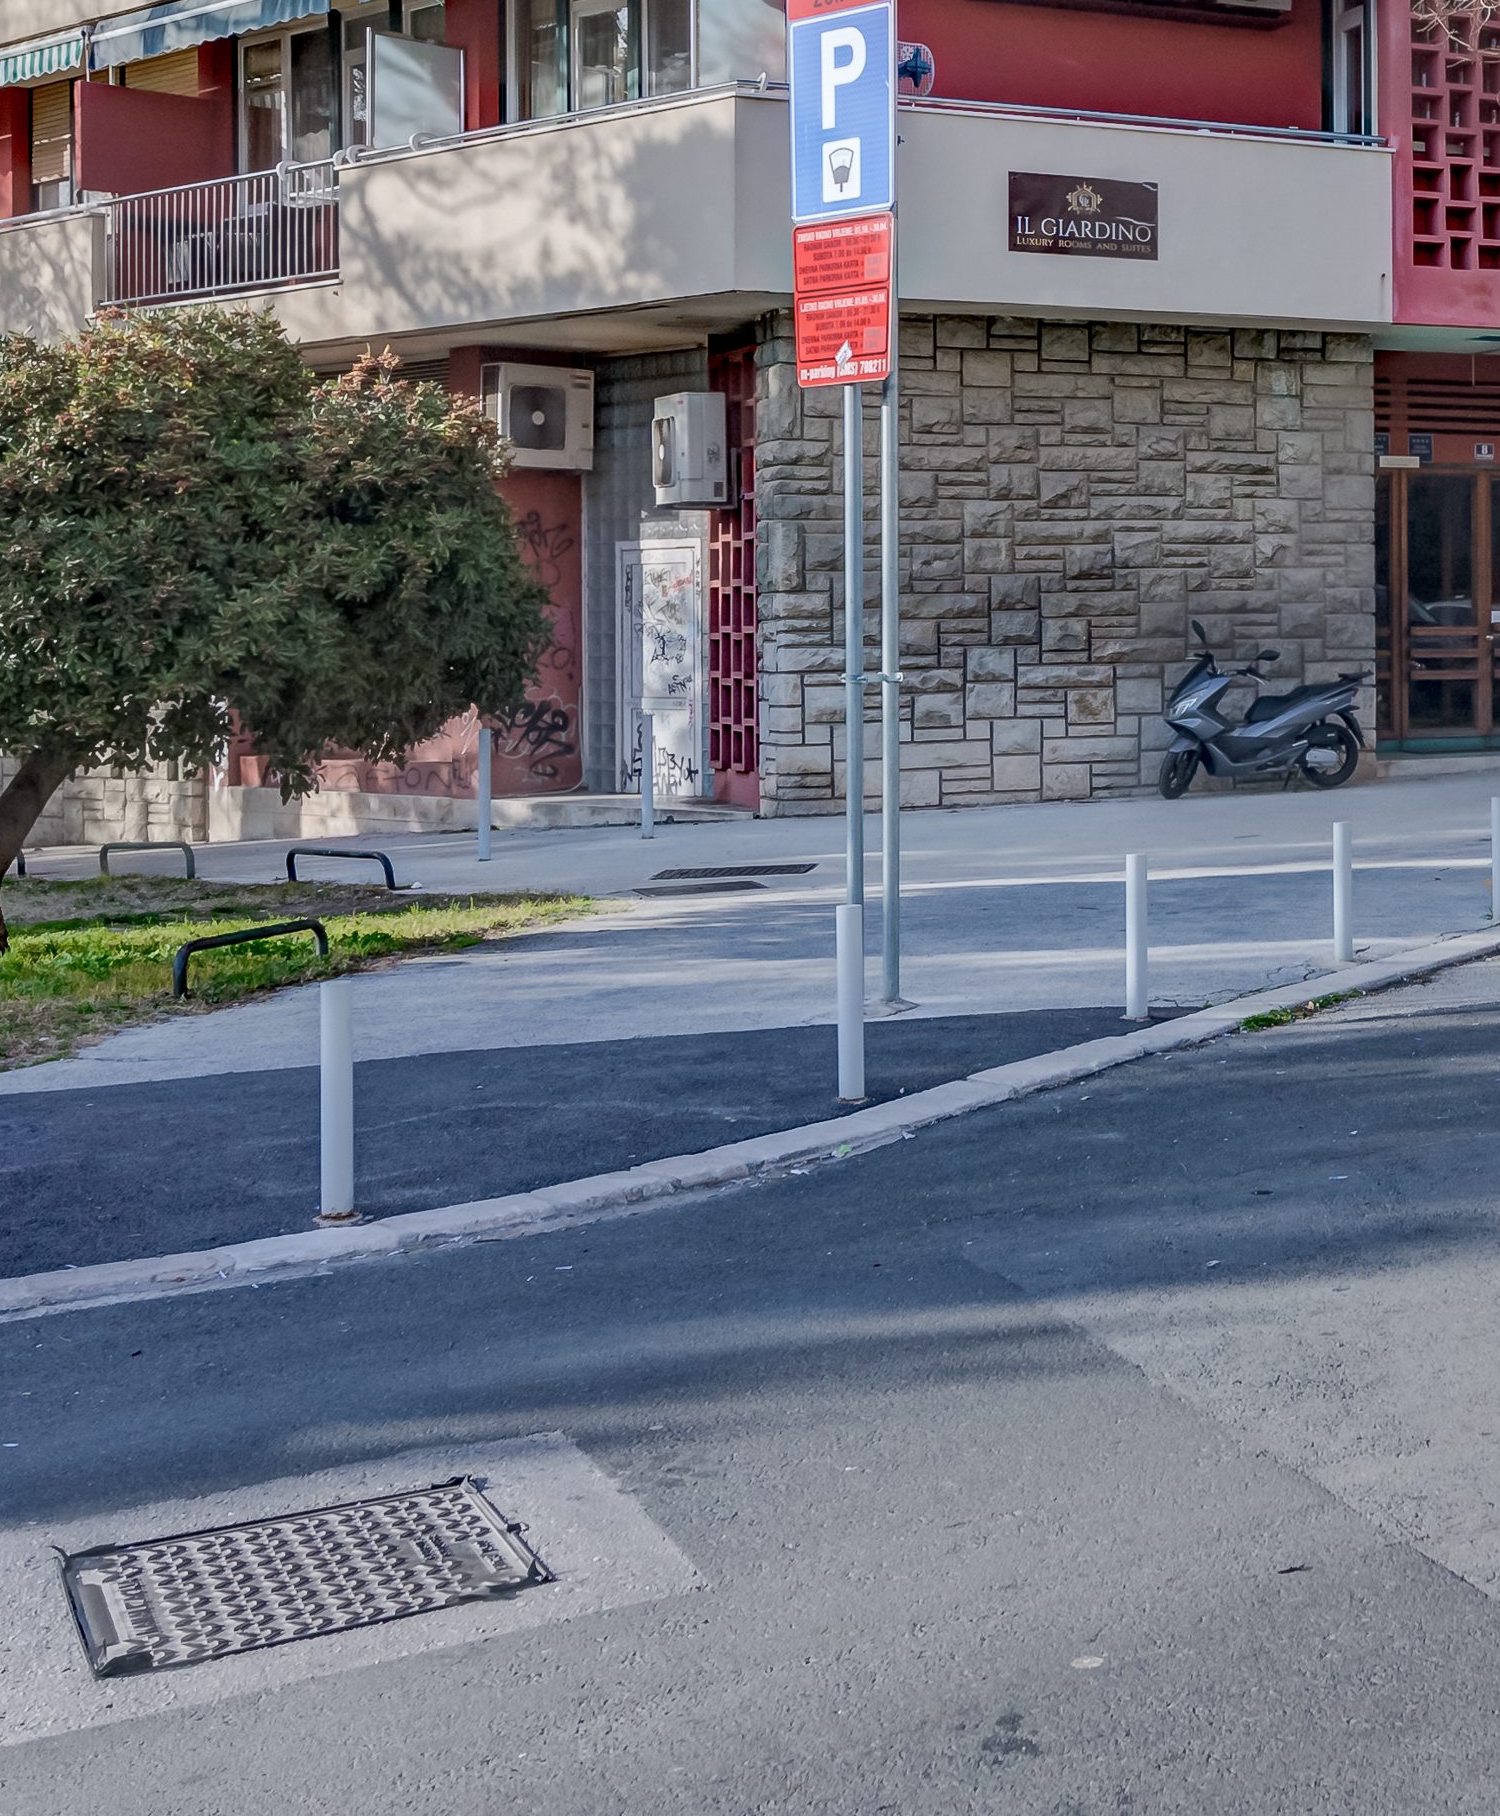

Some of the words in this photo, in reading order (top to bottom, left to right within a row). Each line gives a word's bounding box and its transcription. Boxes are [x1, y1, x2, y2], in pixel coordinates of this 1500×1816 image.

[821, 26, 867, 130] P
[1017, 215, 1035, 235] IL
[1040, 217, 1152, 243] GIARDINO
[1058, 239, 1092, 250] ROOMS
[1096, 242, 1118, 251] AND
[1121, 243, 1152, 253] SUITES
[1481, 444, 1488, 455] 8
